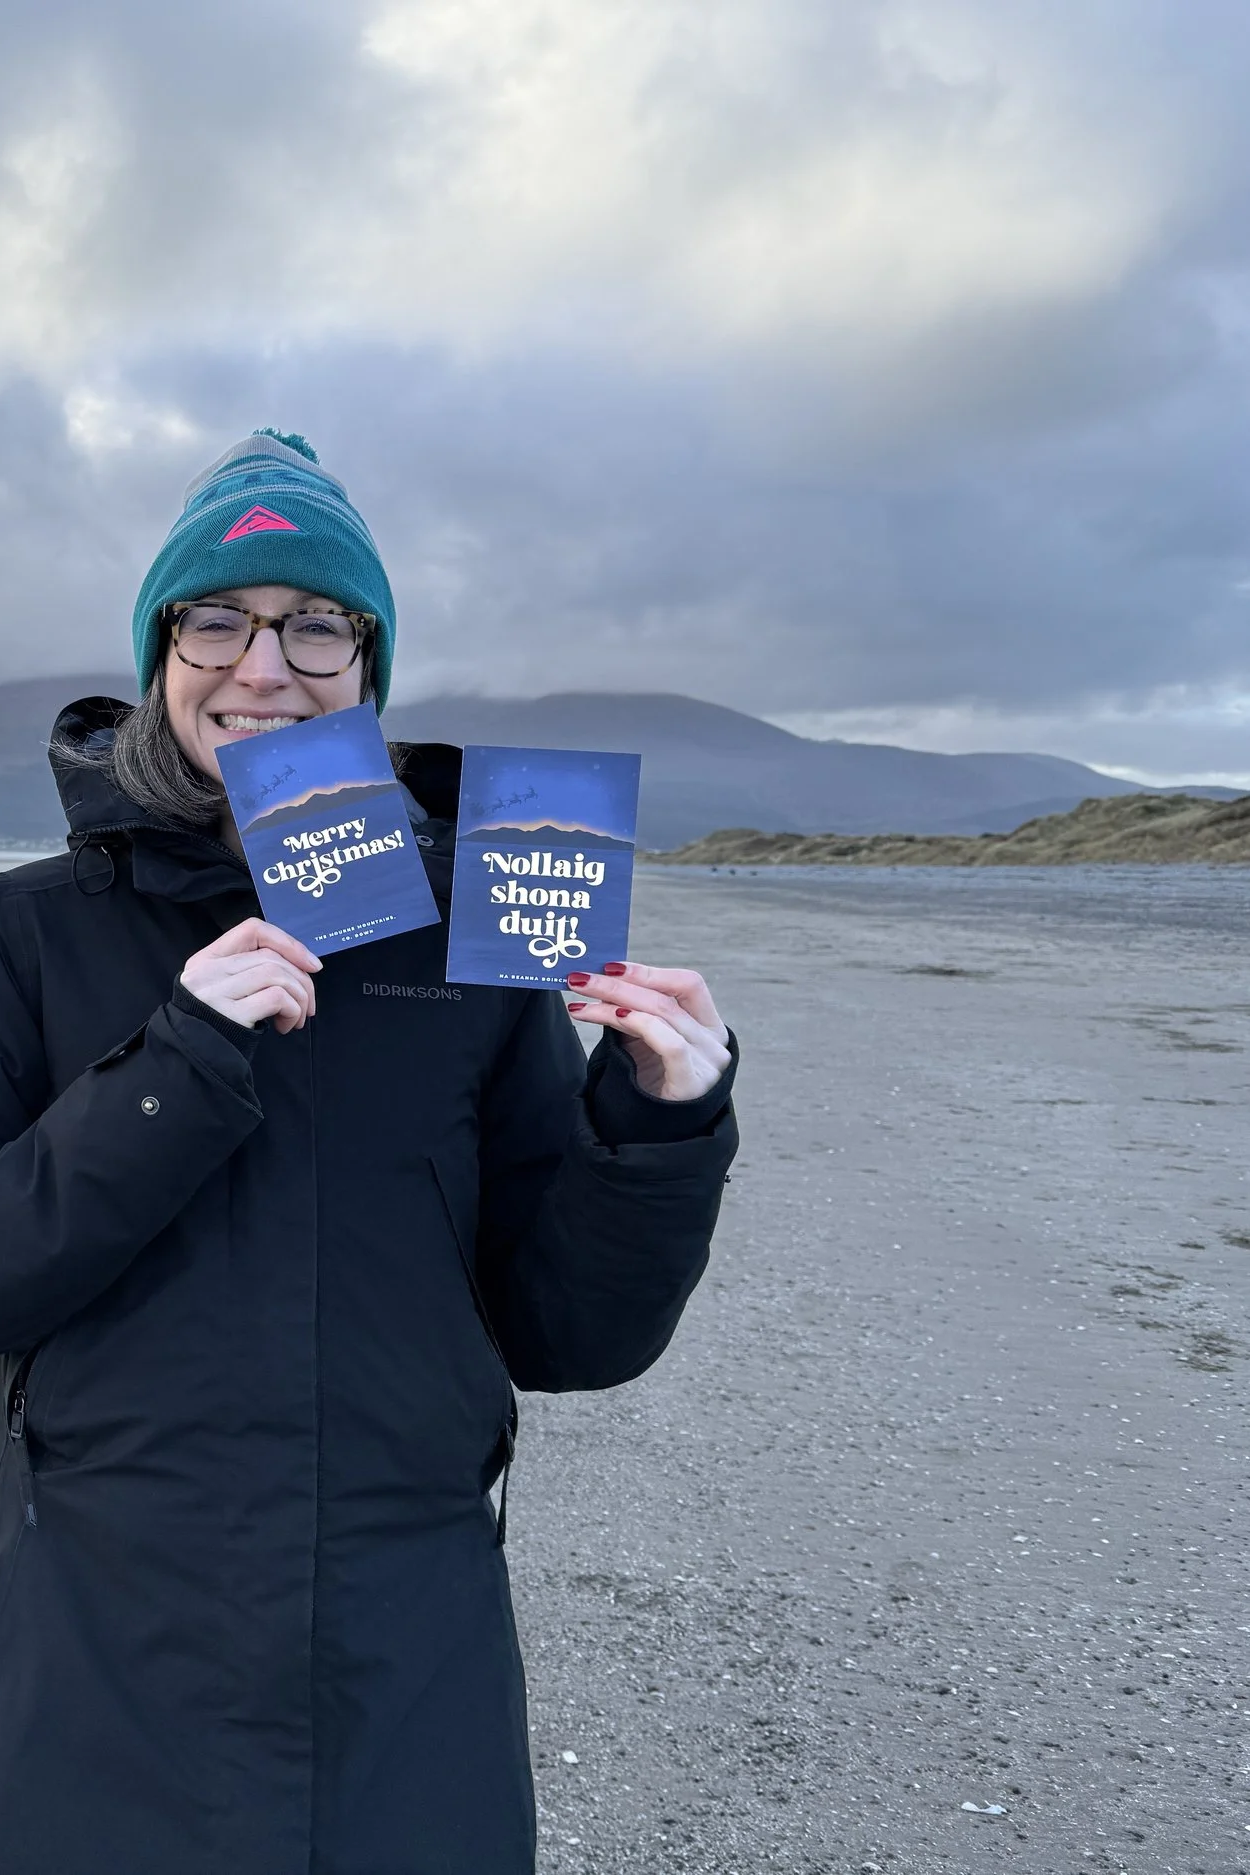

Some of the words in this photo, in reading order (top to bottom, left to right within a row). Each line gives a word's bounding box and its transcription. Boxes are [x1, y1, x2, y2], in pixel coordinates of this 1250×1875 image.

[282, 817, 366, 853] Merry
[263, 829, 405, 898] Christmas!
[482, 851, 606, 886] Nollaig
[490, 880, 591, 910] shona
[314, 934, 327, 942] THE
[354, 929, 374, 939] DOWN
[499, 910, 587, 968] duit!
[362, 982, 462, 1001] DIDRIKSONS
